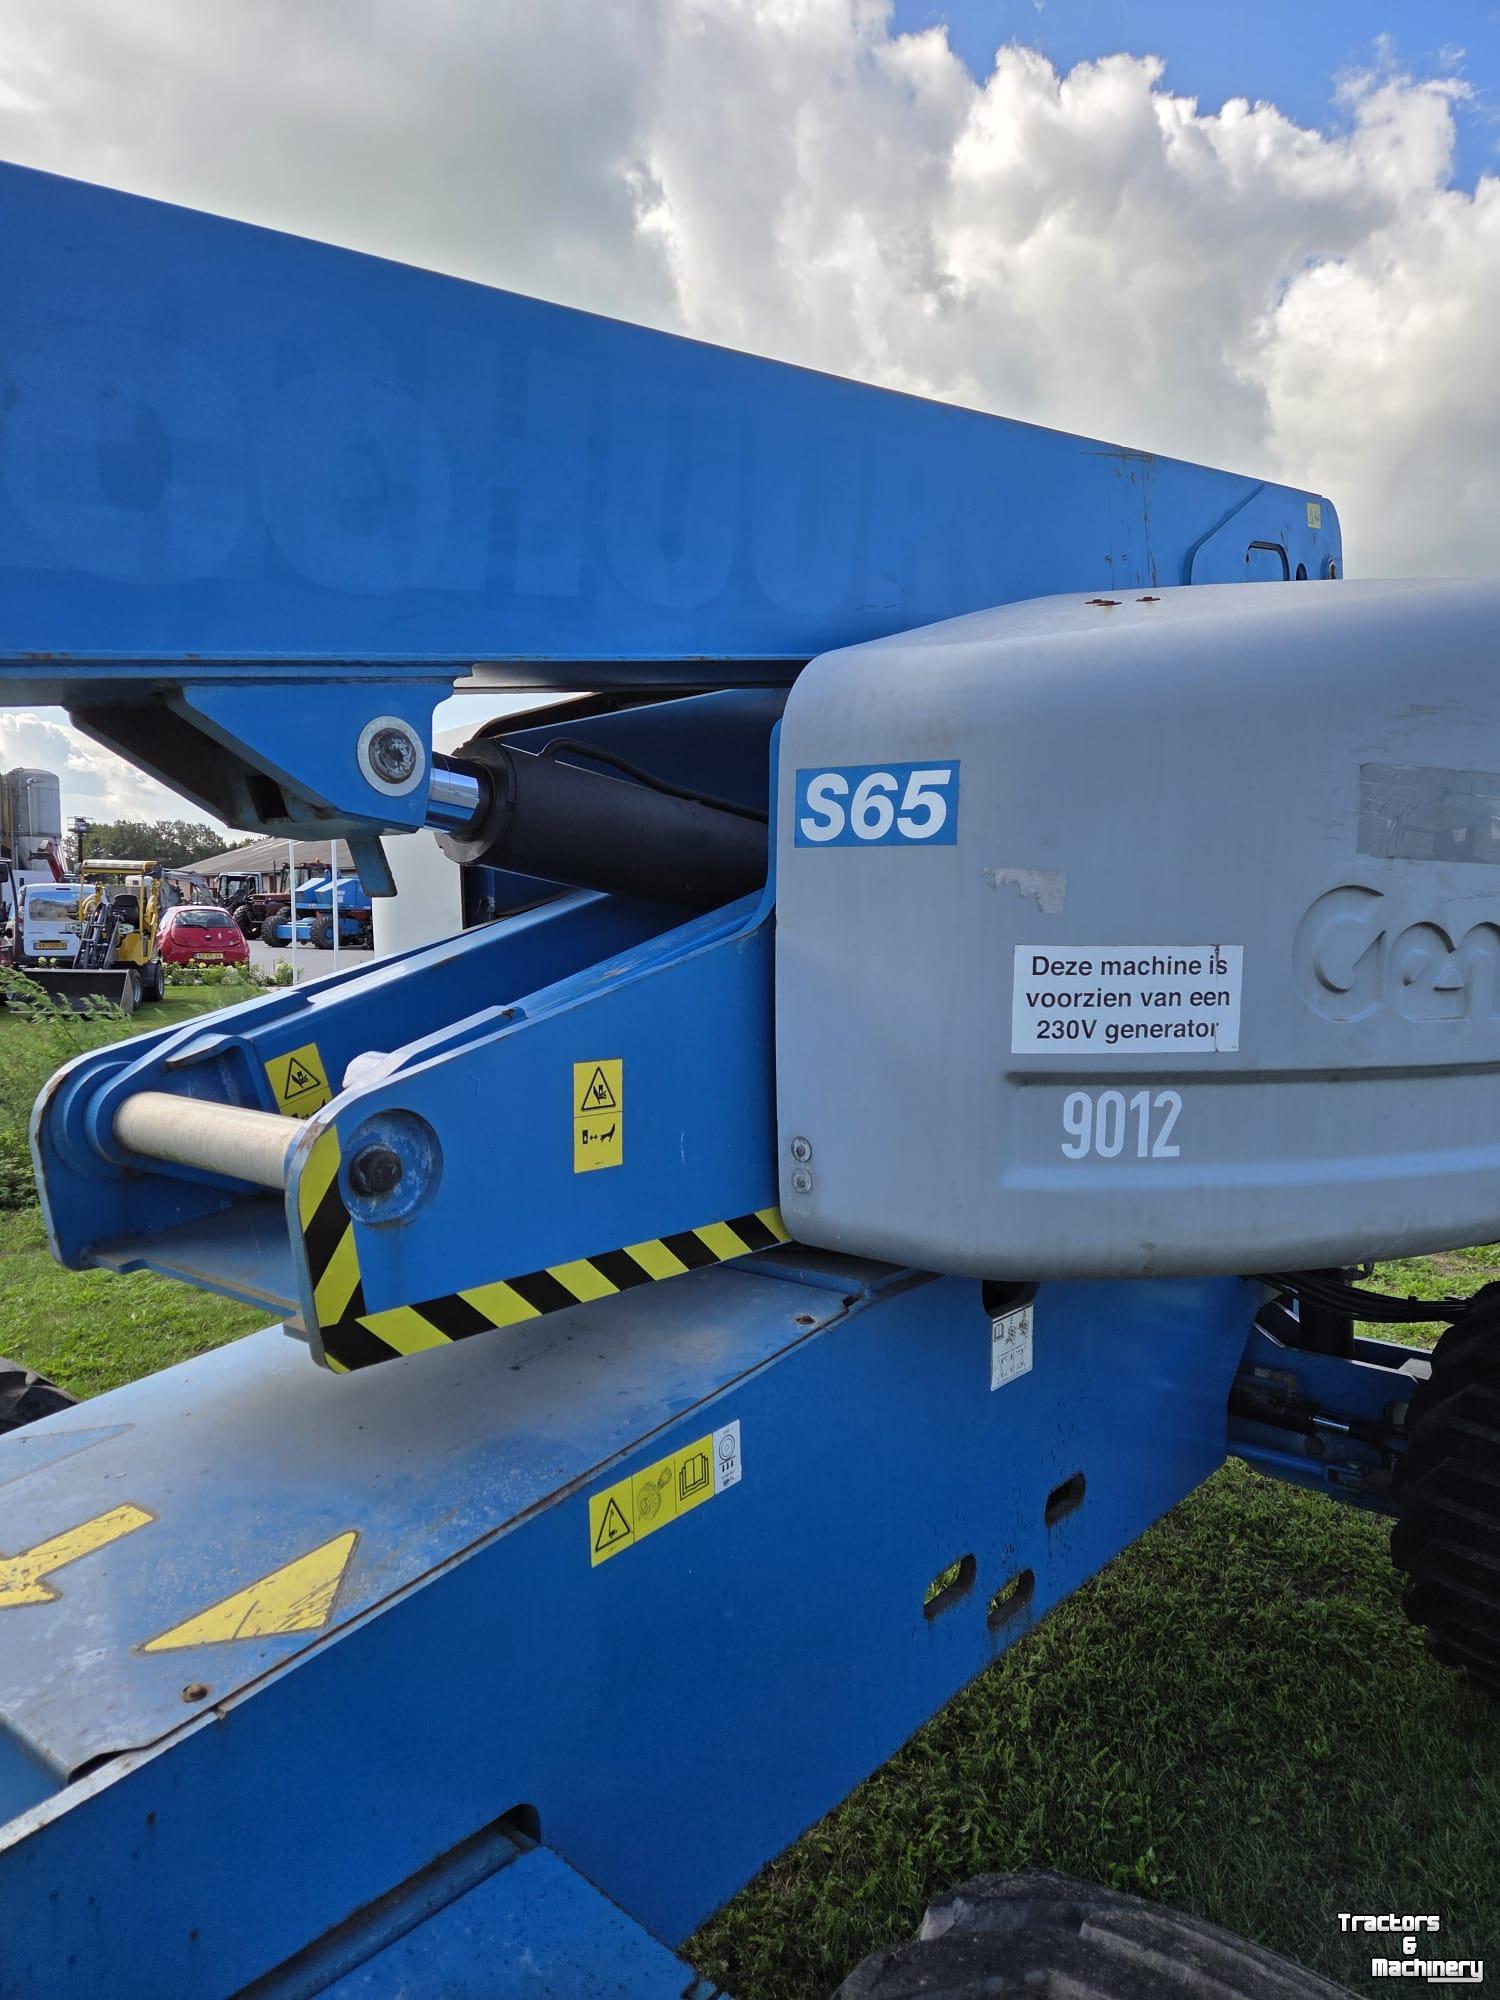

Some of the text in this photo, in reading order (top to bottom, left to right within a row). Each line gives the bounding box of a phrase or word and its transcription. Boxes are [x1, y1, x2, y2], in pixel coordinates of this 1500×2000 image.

[800, 769, 952, 842] S65
[1031, 955, 1228, 976] Deze machine is
[1025, 988, 1231, 1008] voorzien van een
[1036, 1019, 1220, 1044] 230V generator
[1061, 1090, 1183, 1159] 9012
